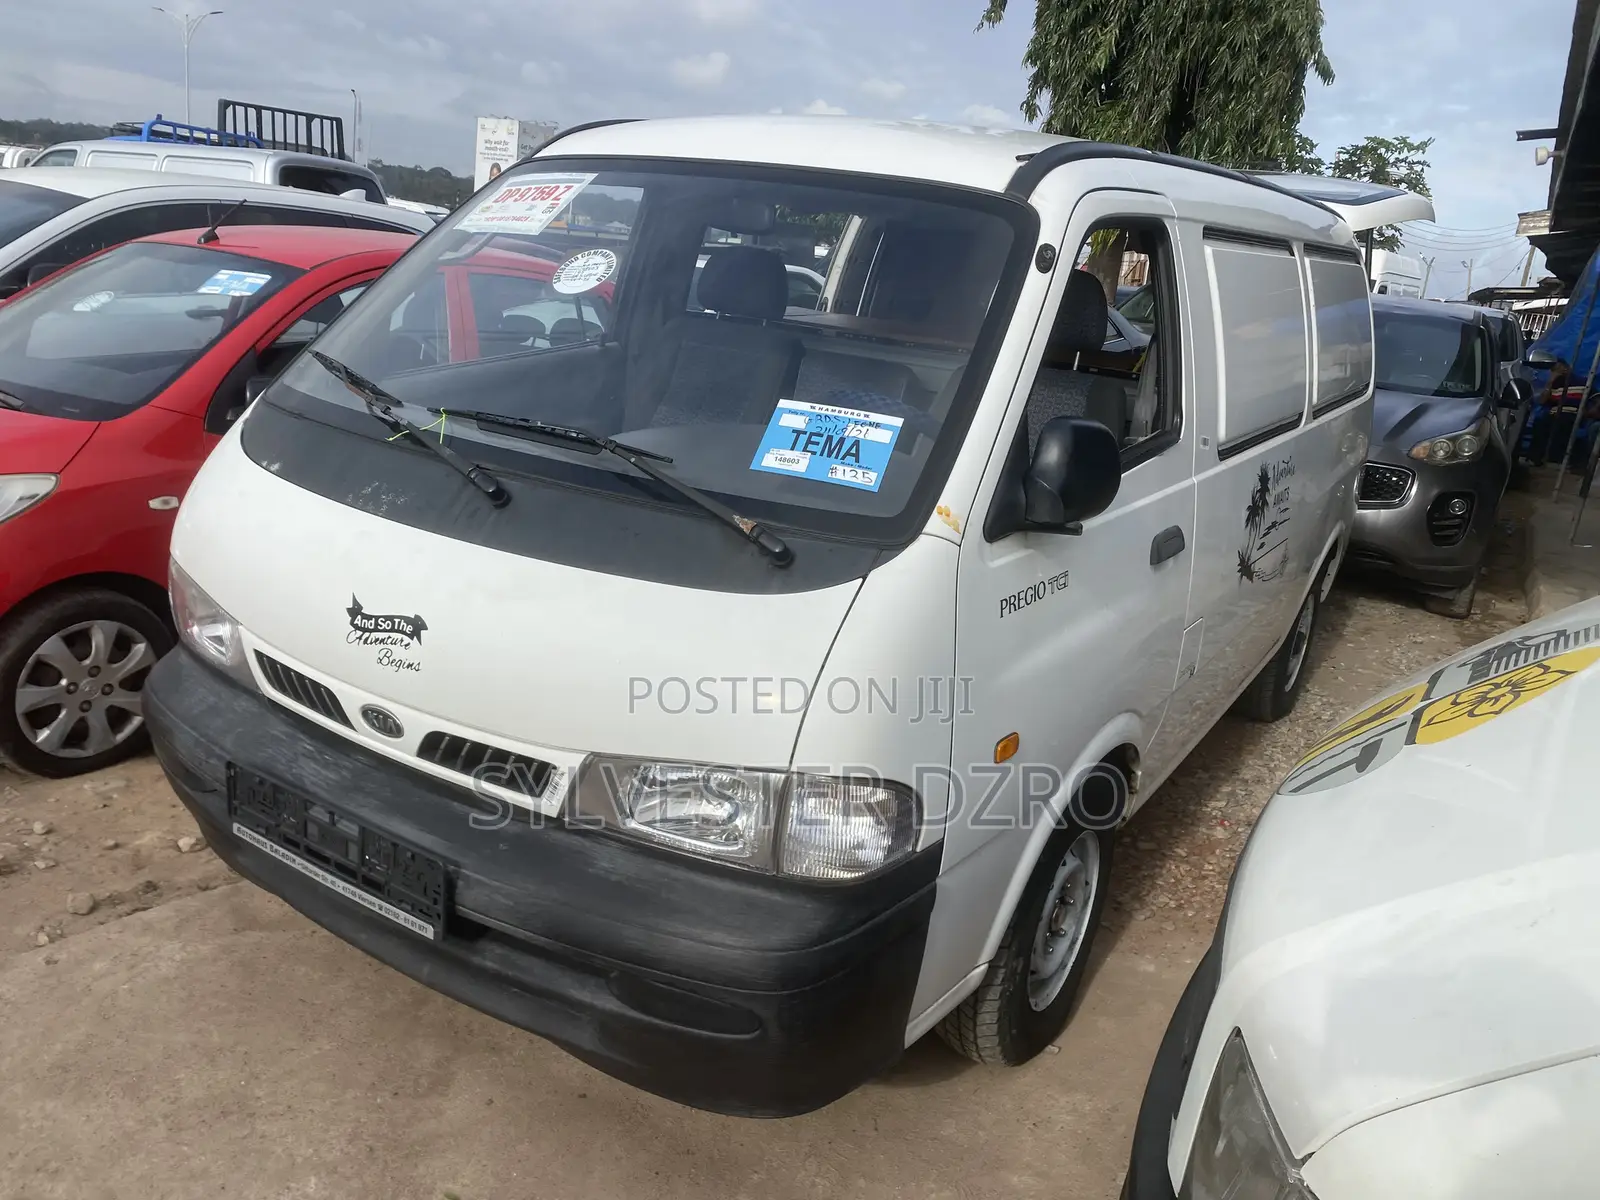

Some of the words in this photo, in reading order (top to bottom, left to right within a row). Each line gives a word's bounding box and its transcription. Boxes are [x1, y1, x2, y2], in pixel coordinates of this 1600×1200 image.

[818, 406, 861, 418] HAMBURG
[789, 429, 861, 463] TEMA
[774, 456, 800, 465] 148603
[829, 466, 873, 483] #125
[999, 580, 1046, 619] PREGIO
[353, 615, 375, 629] And
[377, 617, 392, 630] So
[393, 618, 414, 634] The
[346, 629, 411, 650] Adventure
[376, 648, 422, 672] Begins
